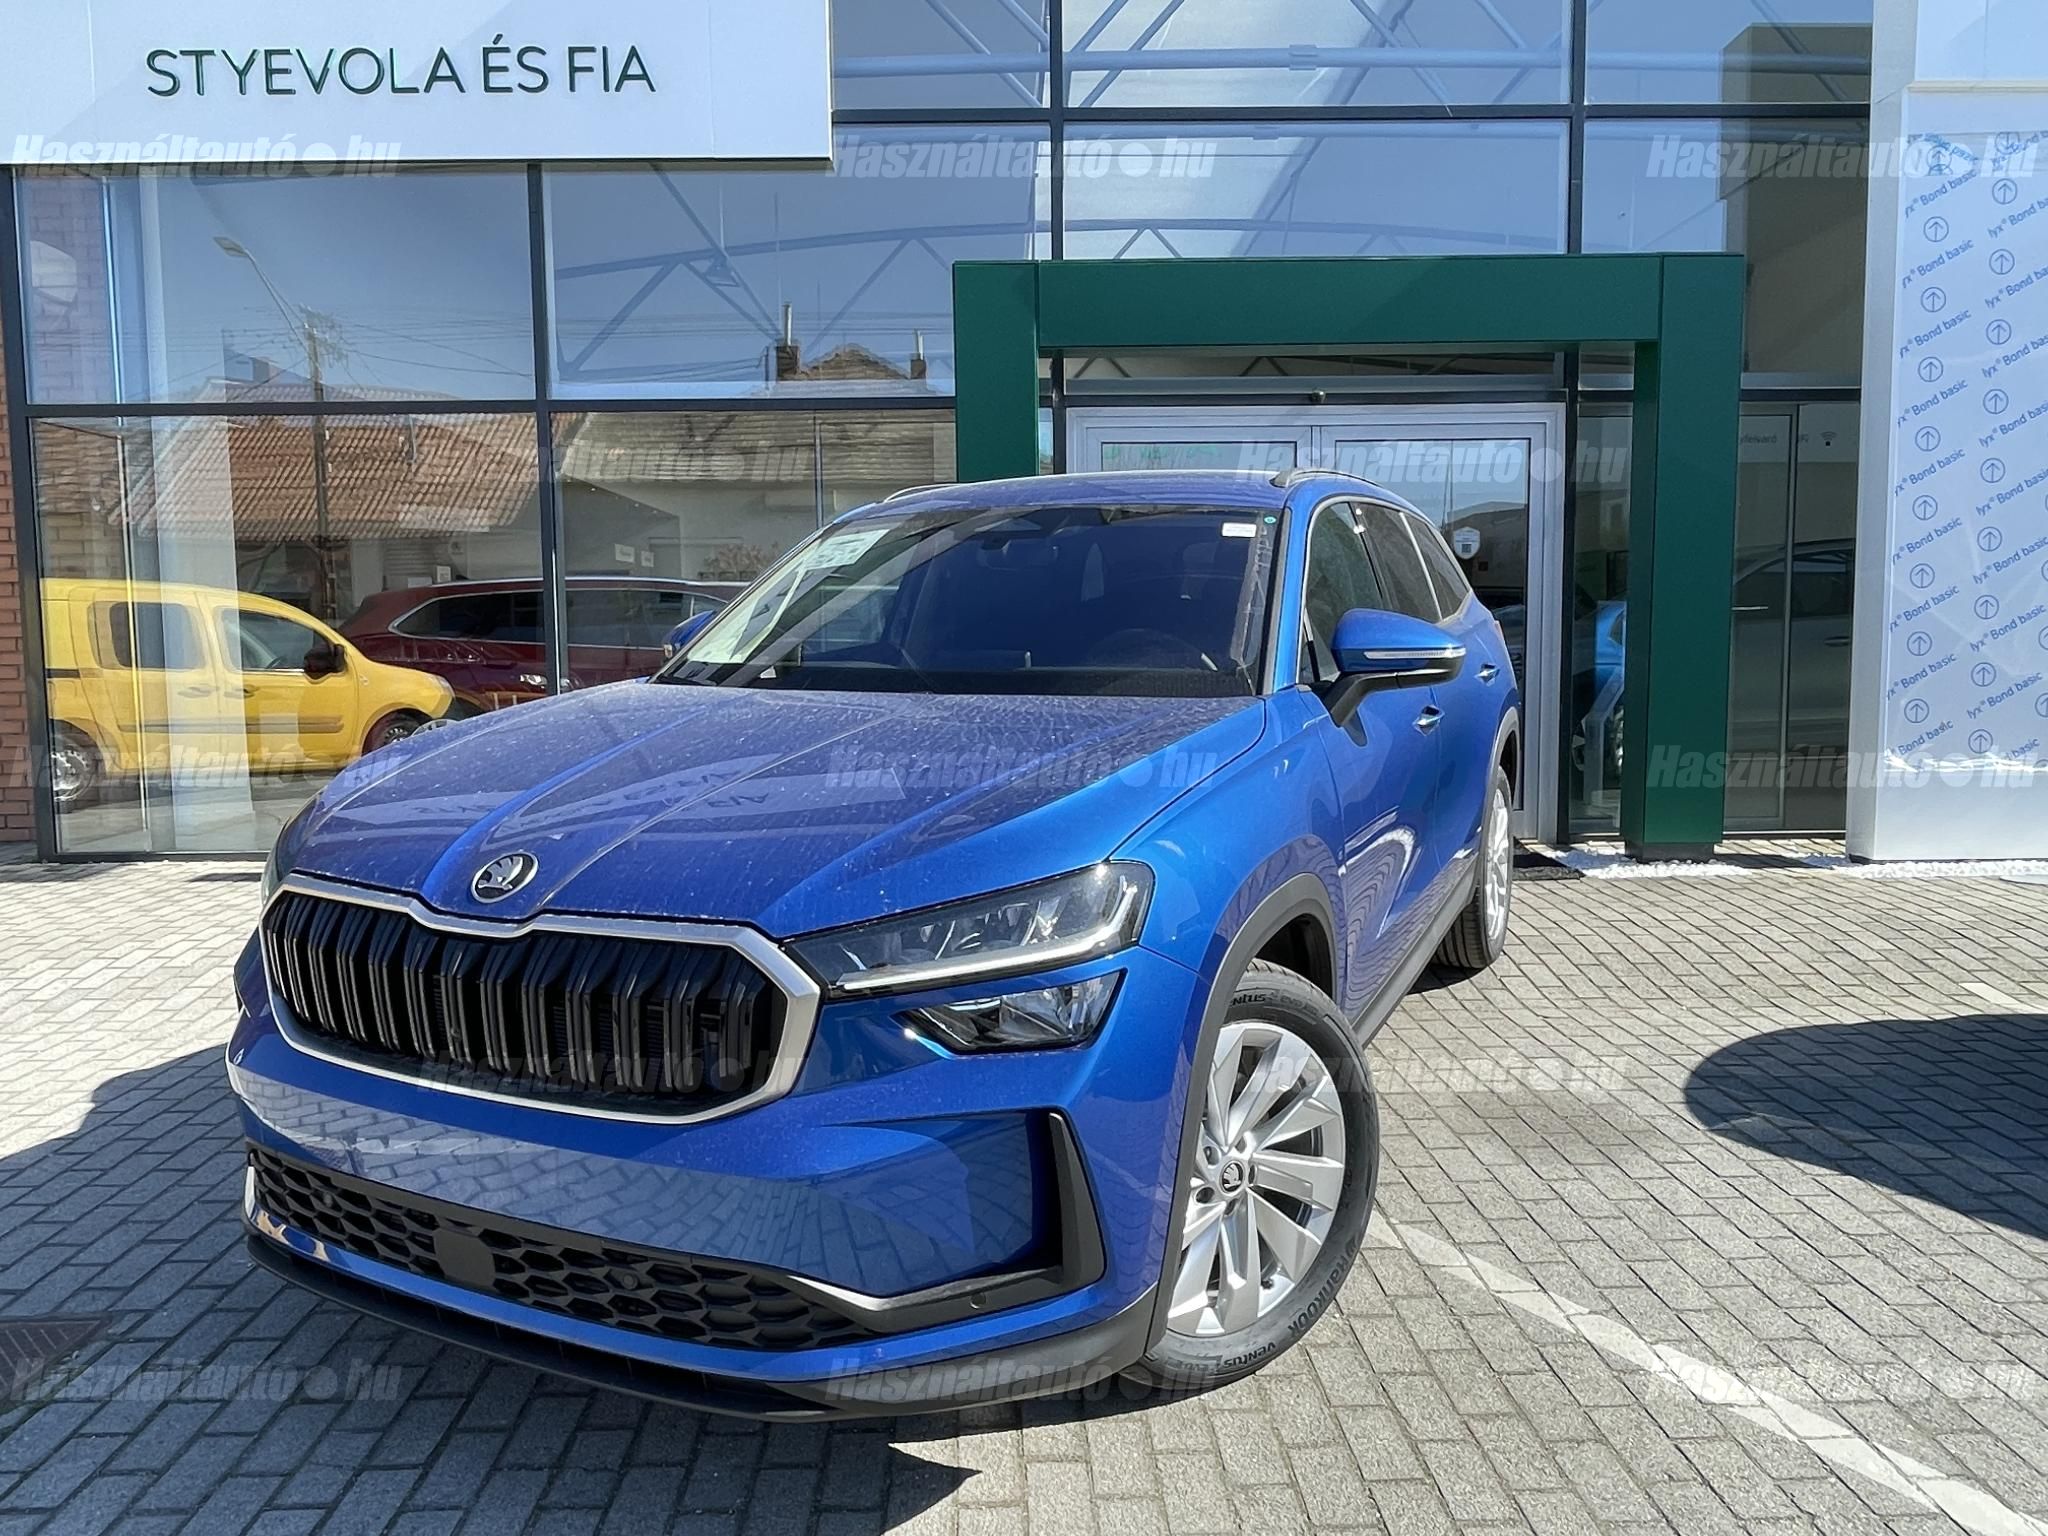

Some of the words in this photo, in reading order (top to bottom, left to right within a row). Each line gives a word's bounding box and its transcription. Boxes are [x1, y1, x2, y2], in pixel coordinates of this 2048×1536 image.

[146, 47, 466, 97] STYEVOLA
[482, 33, 550, 95] ÉS
[567, 45, 657, 95] FIA
[1919, 184, 1947, 206] Bond
[1948, 168, 1977, 189] basic
[2008, 203, 2037, 225] Bond
[1917, 254, 1945, 276] Bond
[1945, 240, 1974, 260] basic
[2005, 274, 2034, 296] Bond
[1914, 324, 1943, 346] Bond
[1942, 310, 1972, 330] basic
[2002, 344, 2031, 366] Bond
[1911, 394, 1940, 416] Bond
[1940, 380, 1968, 400] basic
[1999, 413, 2028, 435] Bond
[1908, 464, 1937, 484] Bond
[1937, 449, 1966, 469] basic
[1996, 483, 2024, 504] Bond
[1905, 532, 1934, 553] Bond
[1934, 517, 1962, 537] basic
[1993, 551, 2021, 573] Bond
[1903, 600, 1931, 622] Bond
[1931, 585, 1960, 605] basic
[1990, 619, 2018, 641] Bond
[2017, 604, 2047, 625] basic
[1901, 668, 1928, 689] Bond
[1928, 653, 1957, 673] basic
[1986, 686, 2014, 708] Bond
[2014, 671, 2043, 692] basic
[1898, 735, 1925, 756] Bond
[2012, 738, 2041, 759] basic
